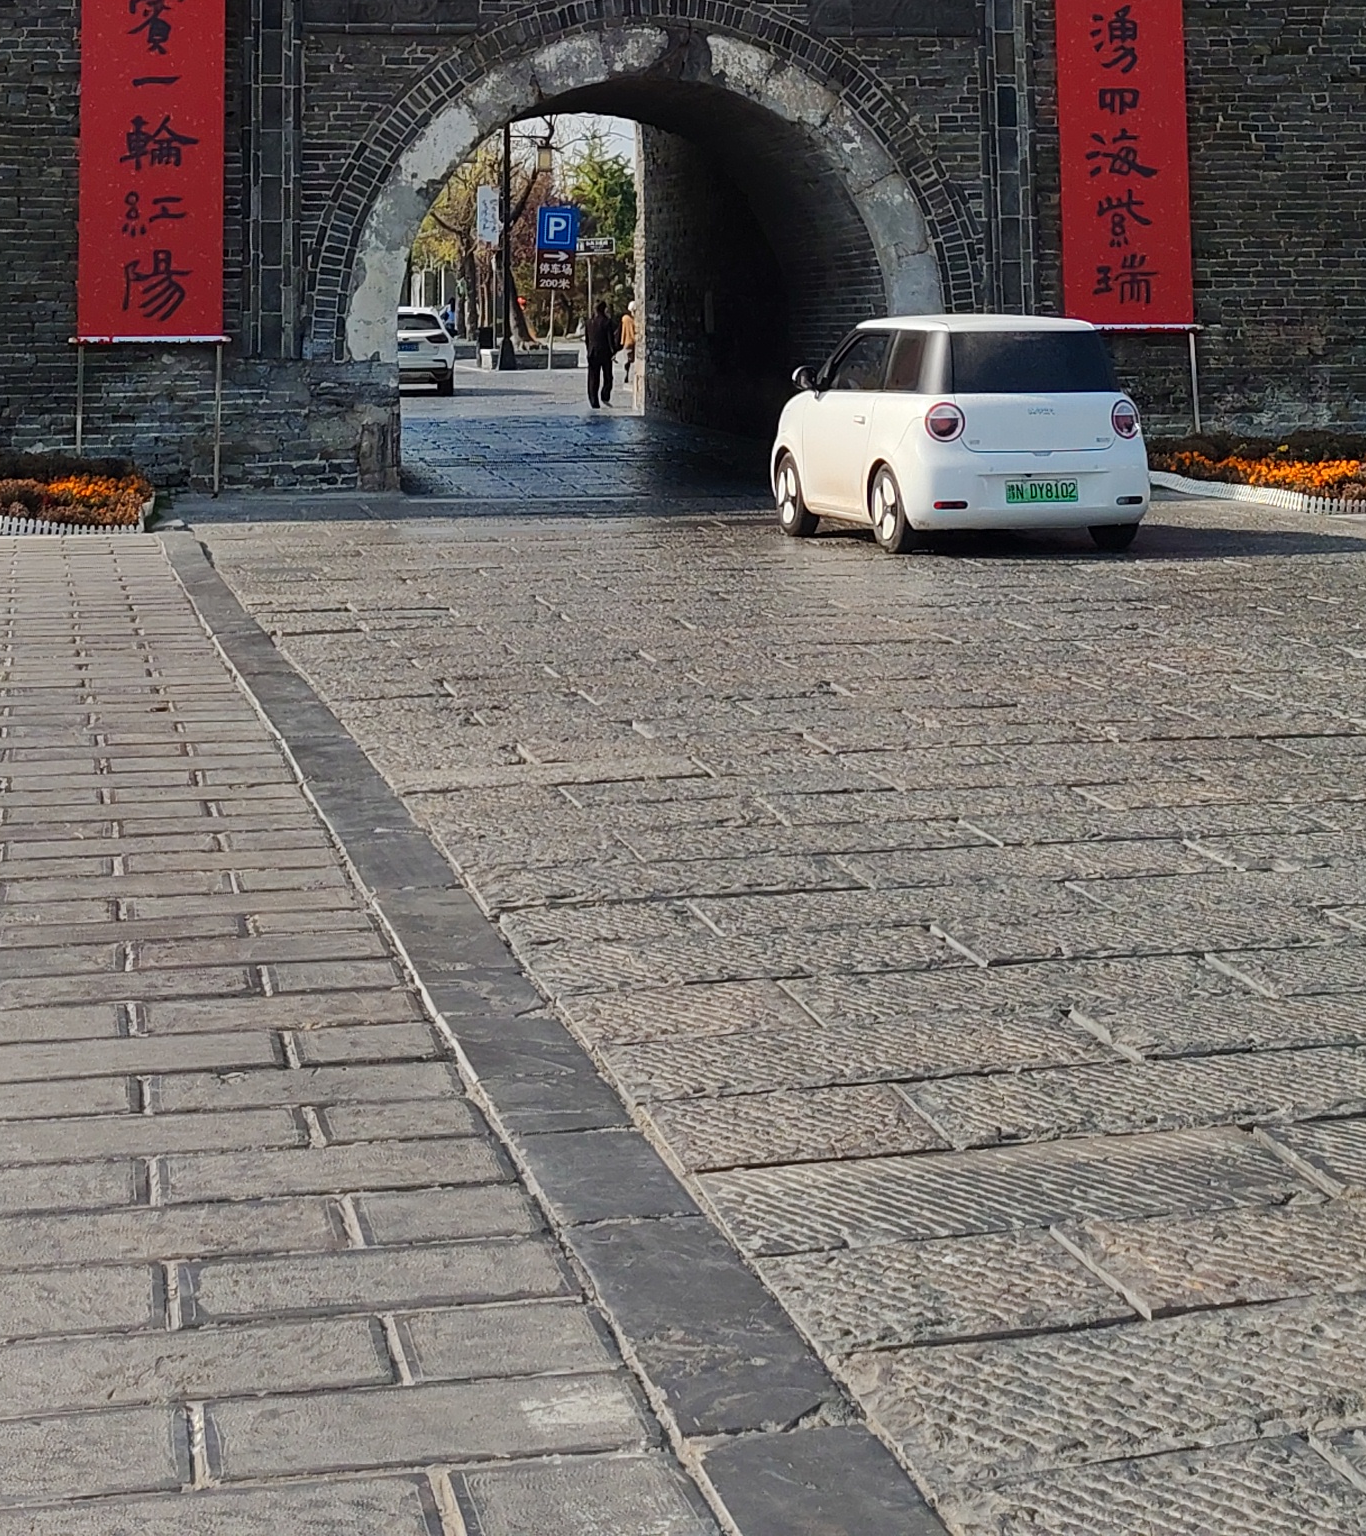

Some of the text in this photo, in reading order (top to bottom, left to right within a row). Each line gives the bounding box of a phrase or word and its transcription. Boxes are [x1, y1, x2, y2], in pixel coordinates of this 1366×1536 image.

[548, 216, 567, 240] P
[539, 263, 573, 275] 停车场
[539, 278, 571, 290] 200米
